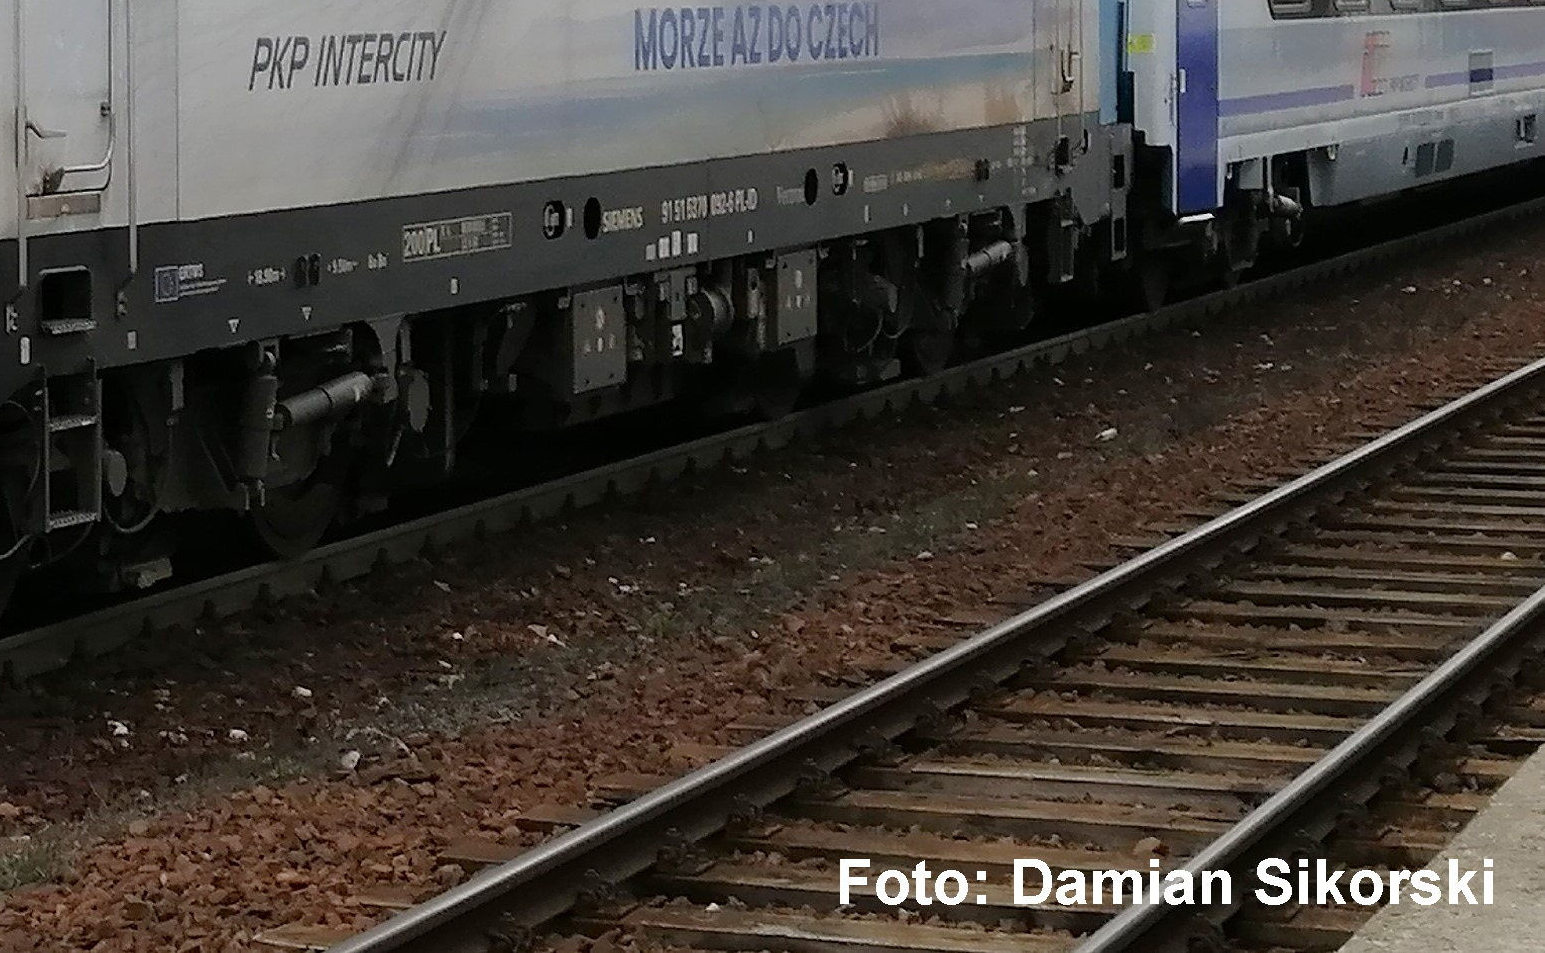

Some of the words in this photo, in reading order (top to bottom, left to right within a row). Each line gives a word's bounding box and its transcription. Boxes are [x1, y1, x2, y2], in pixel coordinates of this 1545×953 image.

[249, 36, 310, 91] PKP
[314, 30, 447, 87] INTERCITY
[634, 7, 724, 71] MORZE
[768, 4, 802, 62] DO
[807, 1, 879, 60] CZECH
[602, 207, 644, 233] SIEMENS
